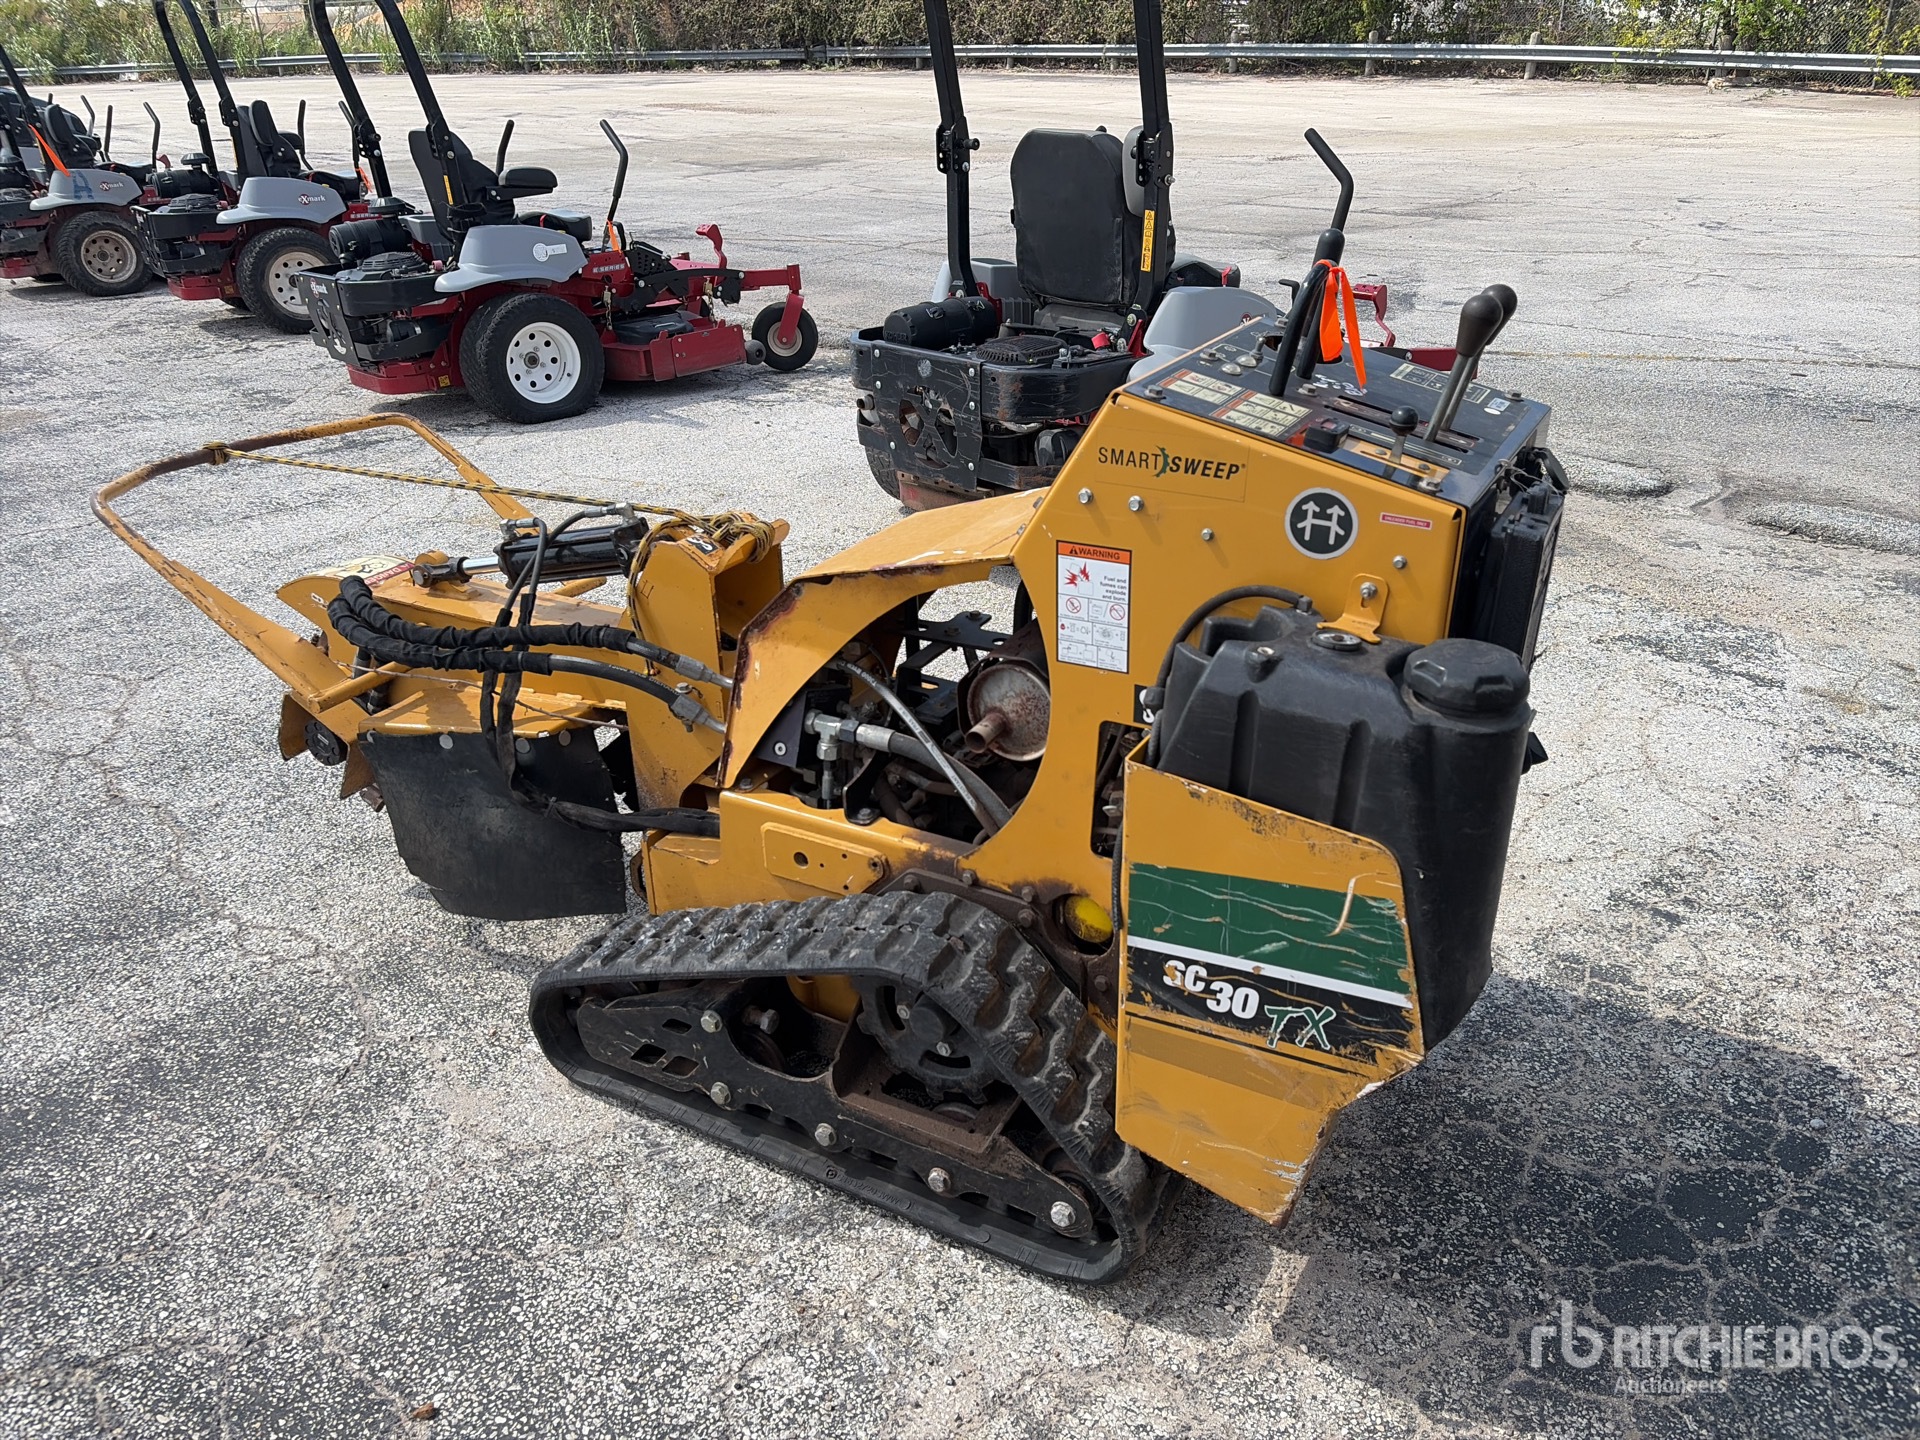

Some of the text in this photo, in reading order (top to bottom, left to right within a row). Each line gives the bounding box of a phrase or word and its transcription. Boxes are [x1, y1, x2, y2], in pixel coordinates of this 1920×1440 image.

[1098, 446, 1240, 480] SMART SWEEP
[1078, 547, 1121, 560] WARNING
[1105, 588, 1126, 596] explode
[1263, 1004, 1337, 1049] TX
